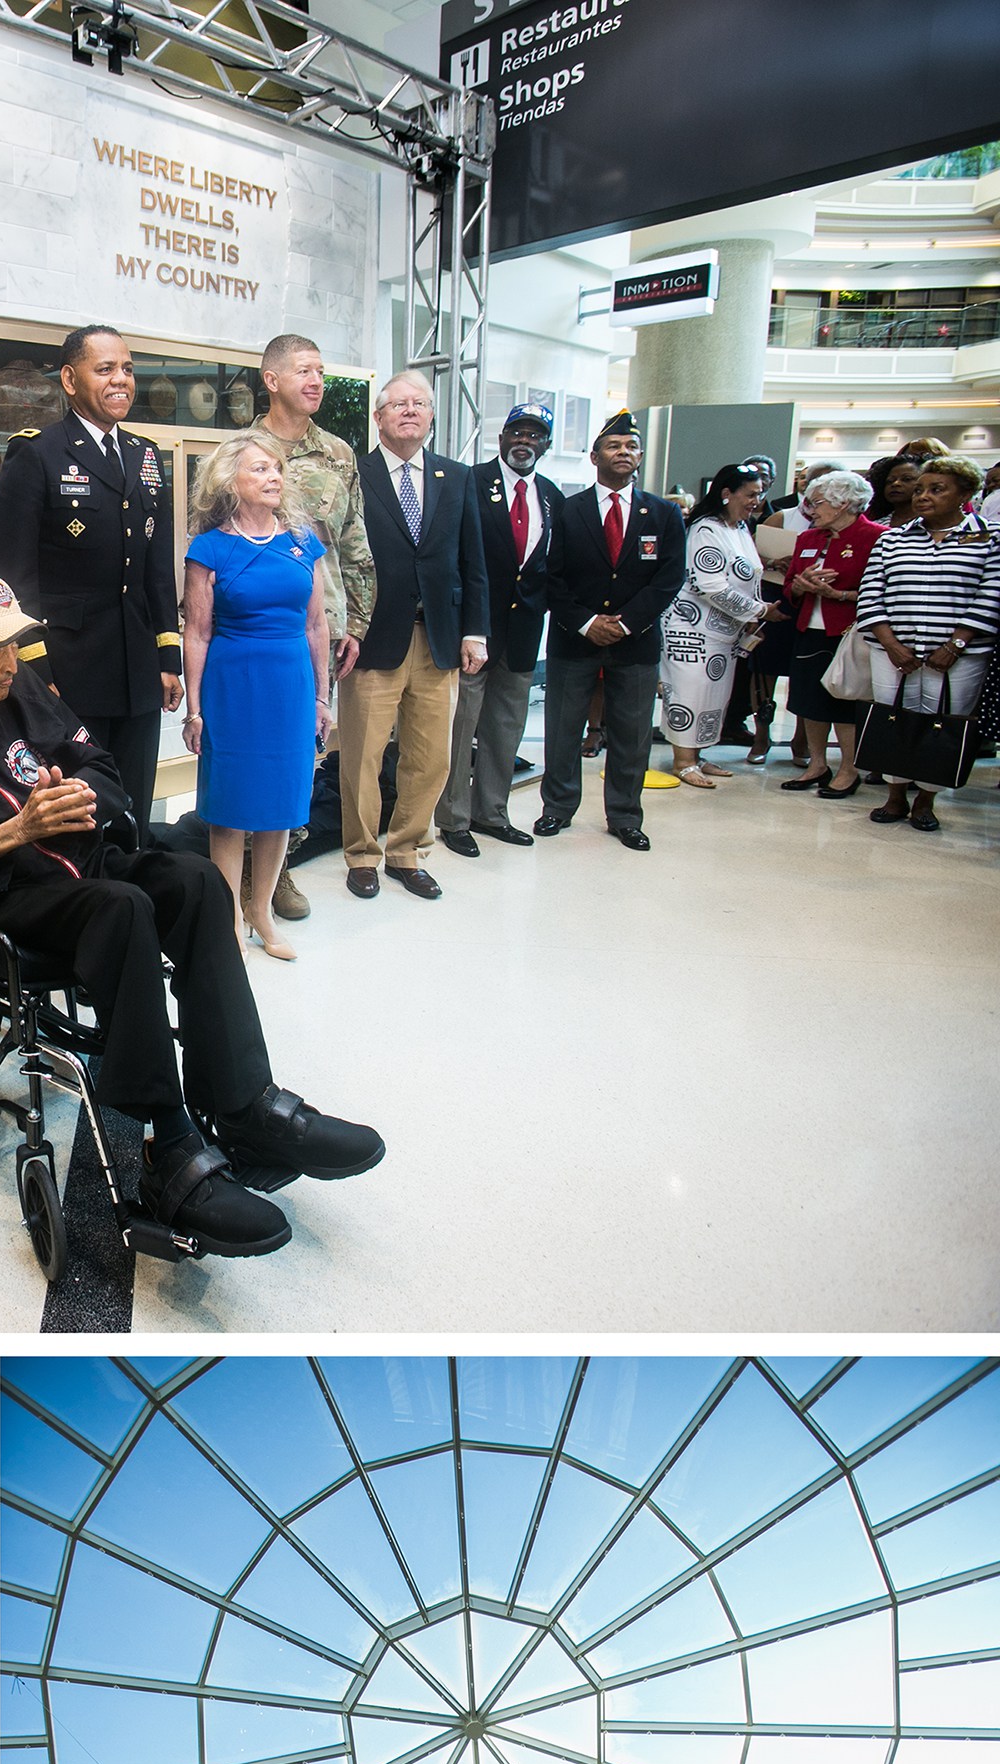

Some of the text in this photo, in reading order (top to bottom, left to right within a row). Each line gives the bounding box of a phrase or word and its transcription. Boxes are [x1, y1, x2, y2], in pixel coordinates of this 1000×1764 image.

[500, 13, 623, 76] Restaurantes
[499, 61, 586, 112] Shops
[498, 95, 566, 132] Tiendas
[93, 136, 278, 209] WHERE LIBERTY
[140, 187, 240, 237] DWELLS,
[139, 222, 240, 265] THERE IS
[116, 253, 260, 301] MY COUNTRY
